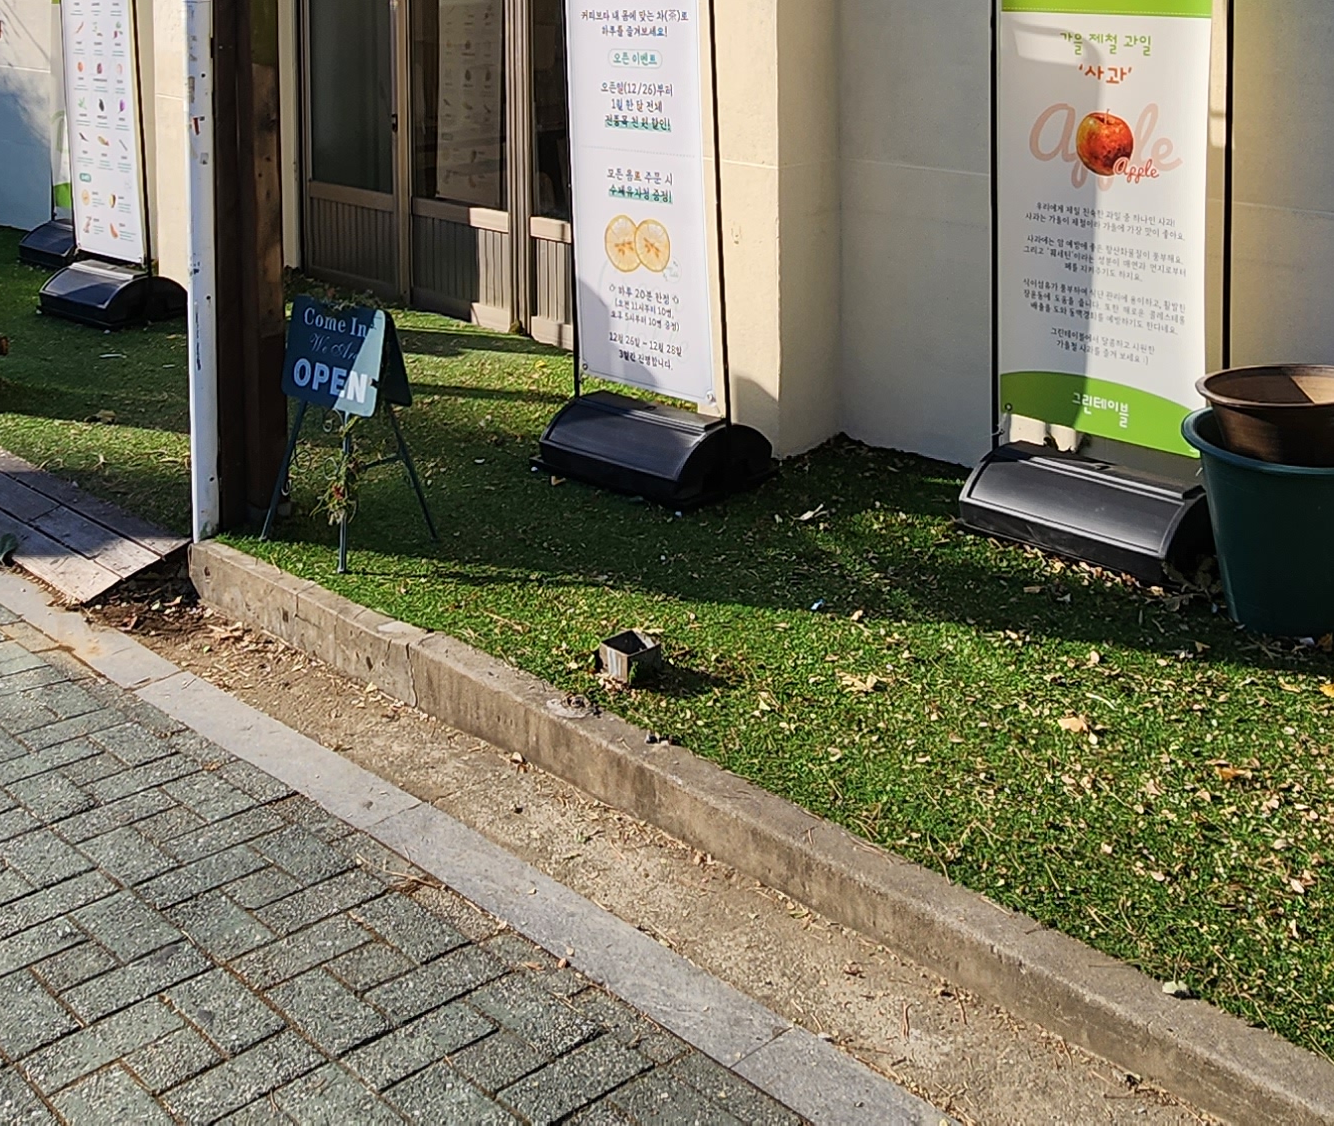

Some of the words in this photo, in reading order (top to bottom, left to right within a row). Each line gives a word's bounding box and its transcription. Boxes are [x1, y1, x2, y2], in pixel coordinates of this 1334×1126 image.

[581, 10, 609, 21] 커피보다
[612, 10, 619, 21] 내
[622, 10, 636, 21] 몸에
[639, 10, 654, 22] 맞는
[1060, 32, 1083, 56] 가을
[1089, 33, 1118, 54] 제철
[1123, 35, 1151, 56] 과일
[613, 52, 629, 65] 오픈
[632, 52, 657, 66] 이벤트
[626, 99, 633, 111] 한
[636, 100, 643, 112] 달
[607, 169, 623, 180] 모든
[626, 169, 642, 182] 음료
[644, 171, 661, 184] 주문
[665, 173, 673, 186] 시
[1113, 157, 1160, 184] Apple
[1025, 212, 1046, 223] 사과는
[1049, 215, 1069, 225] 가을이
[1102, 223, 1125, 233] 가을에
[1127, 225, 1142, 235] 가장
[1037, 202, 1064, 212] 우리에게
[1066, 205, 1080, 215] 제일
[1106, 210, 1121, 221] 과일
[1133, 214, 1156, 225] 하나인
[1023, 245, 1044, 255] 그리고
[1027, 234, 1055, 246] 사과에는
[304, 307, 347, 333] Come
[350, 317, 367, 337] In
[293, 358, 368, 404] OPEN
[1072, 392, 1129, 428] 그린테이블
